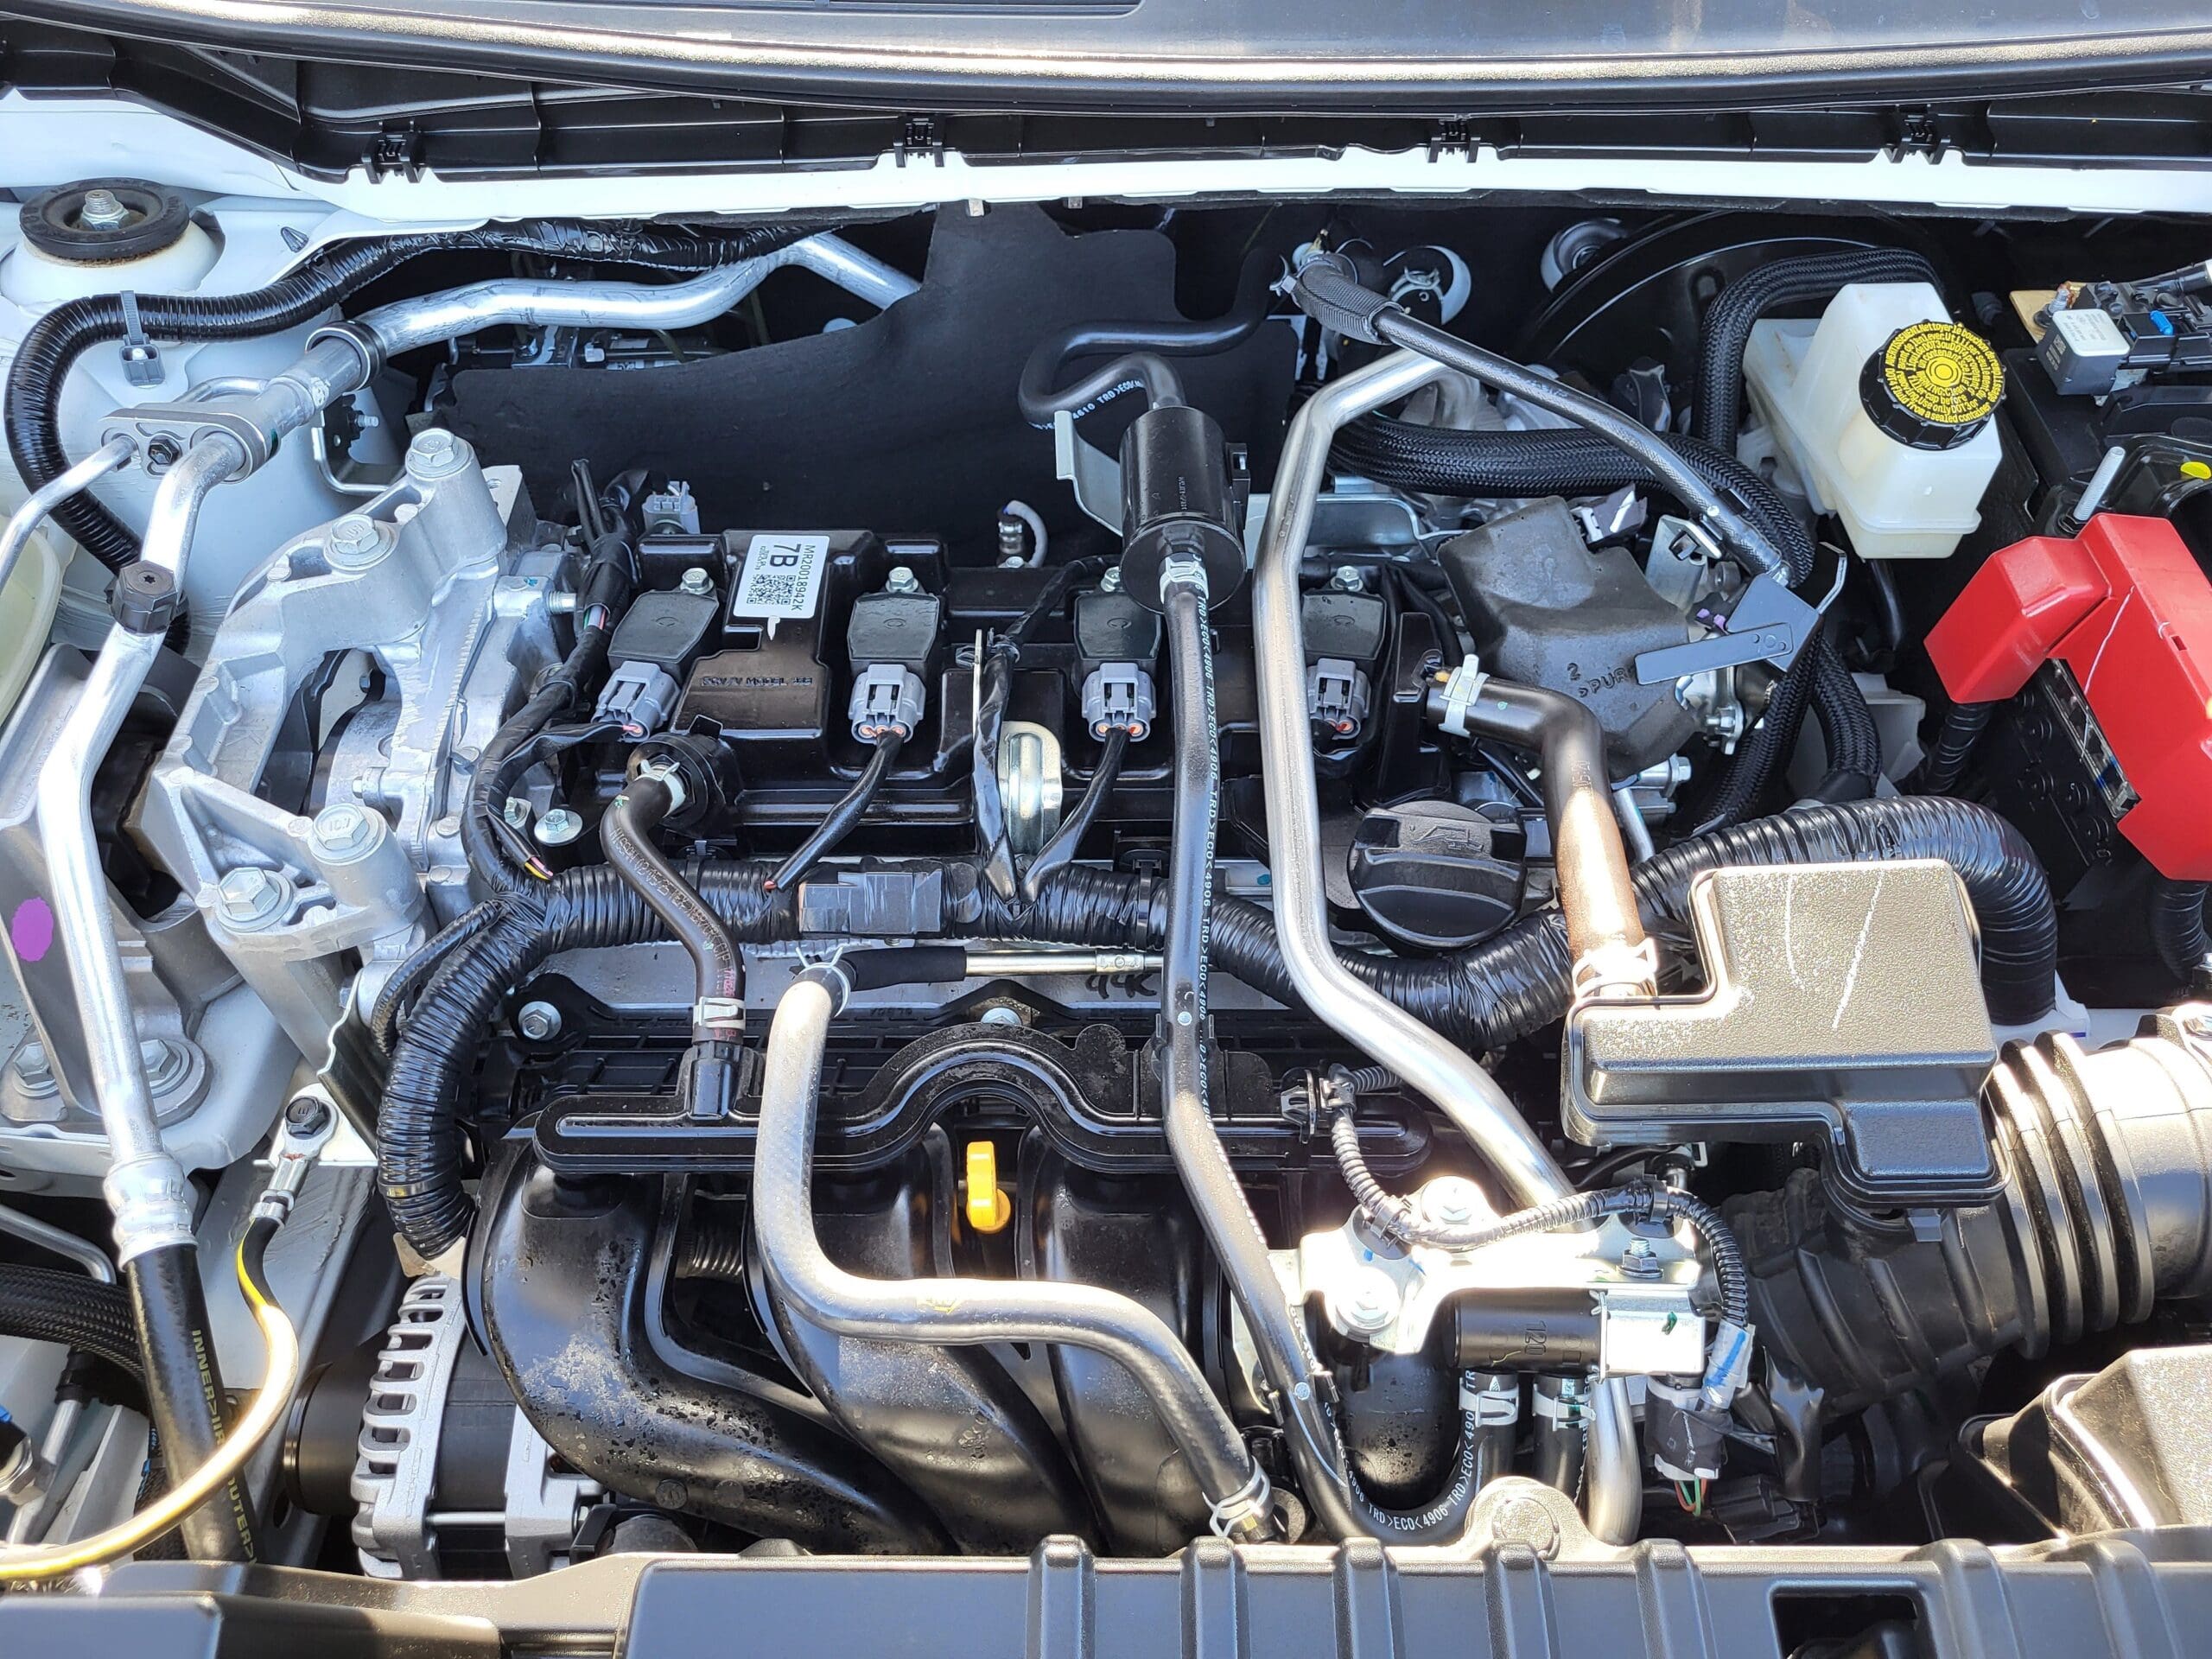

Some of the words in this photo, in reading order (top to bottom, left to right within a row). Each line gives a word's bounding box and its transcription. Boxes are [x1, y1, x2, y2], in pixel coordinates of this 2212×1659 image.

[1961, 328, 1989, 352] bouchon
[1925, 392, 1940, 404] cap
[1940, 395, 1968, 405] before
[1924, 410, 1931, 419] a
[1930, 413, 1959, 423] sealed
[770, 543, 802, 568] 7B
[791, 544, 816, 611] MR20018942K
[1368, 1502, 1449, 1531] TRD>ECO<4906
